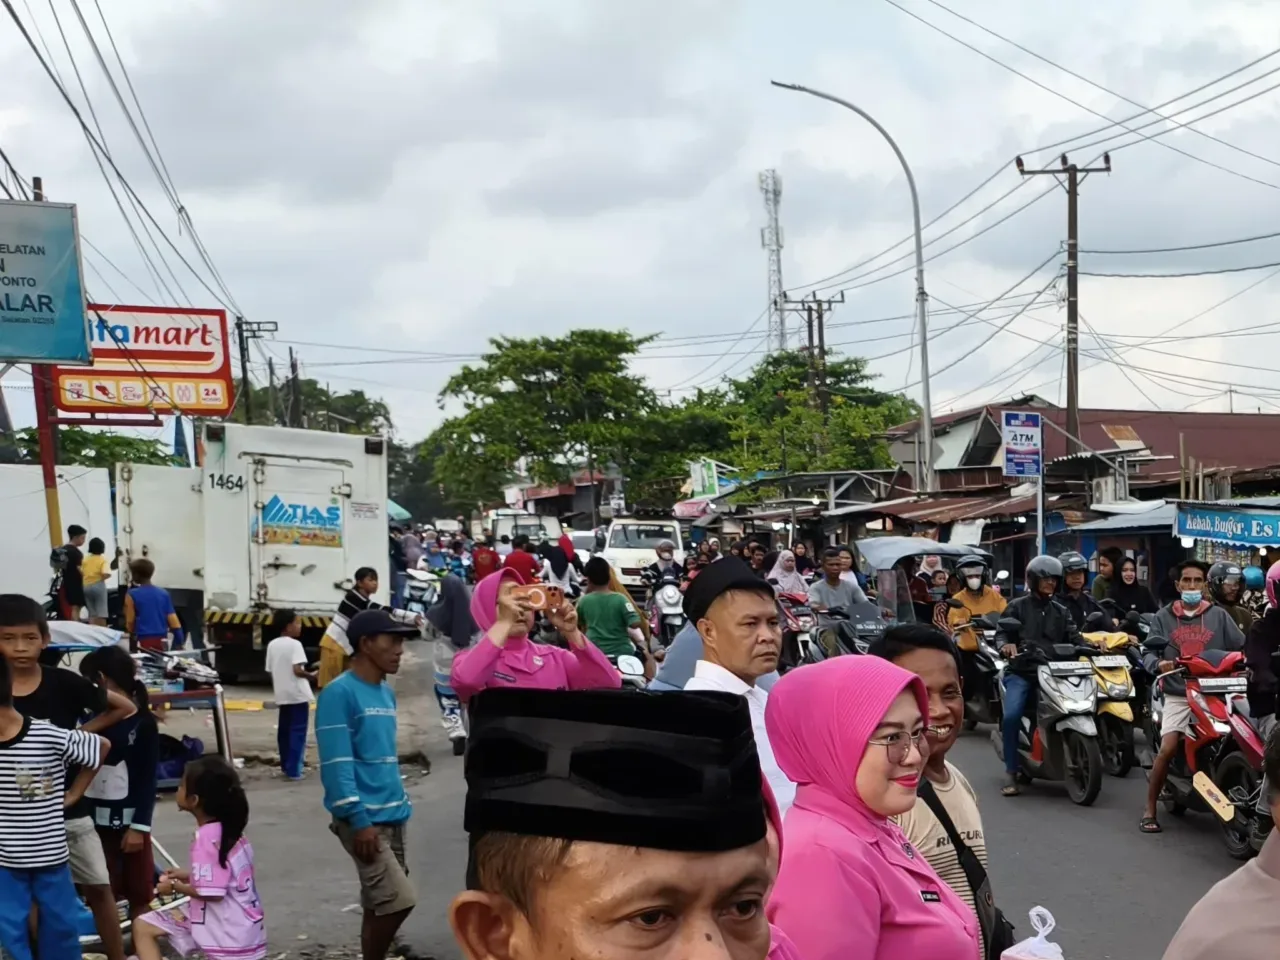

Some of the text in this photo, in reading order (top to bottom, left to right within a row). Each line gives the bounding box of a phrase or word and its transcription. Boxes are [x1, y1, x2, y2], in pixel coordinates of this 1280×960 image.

[0, 276, 37, 287] ONTO
[204, 388, 217, 396] 24
[1011, 433, 1034, 443] ATM
[209, 473, 244, 491] 1464
[1251, 520, 1274, 537] Es
